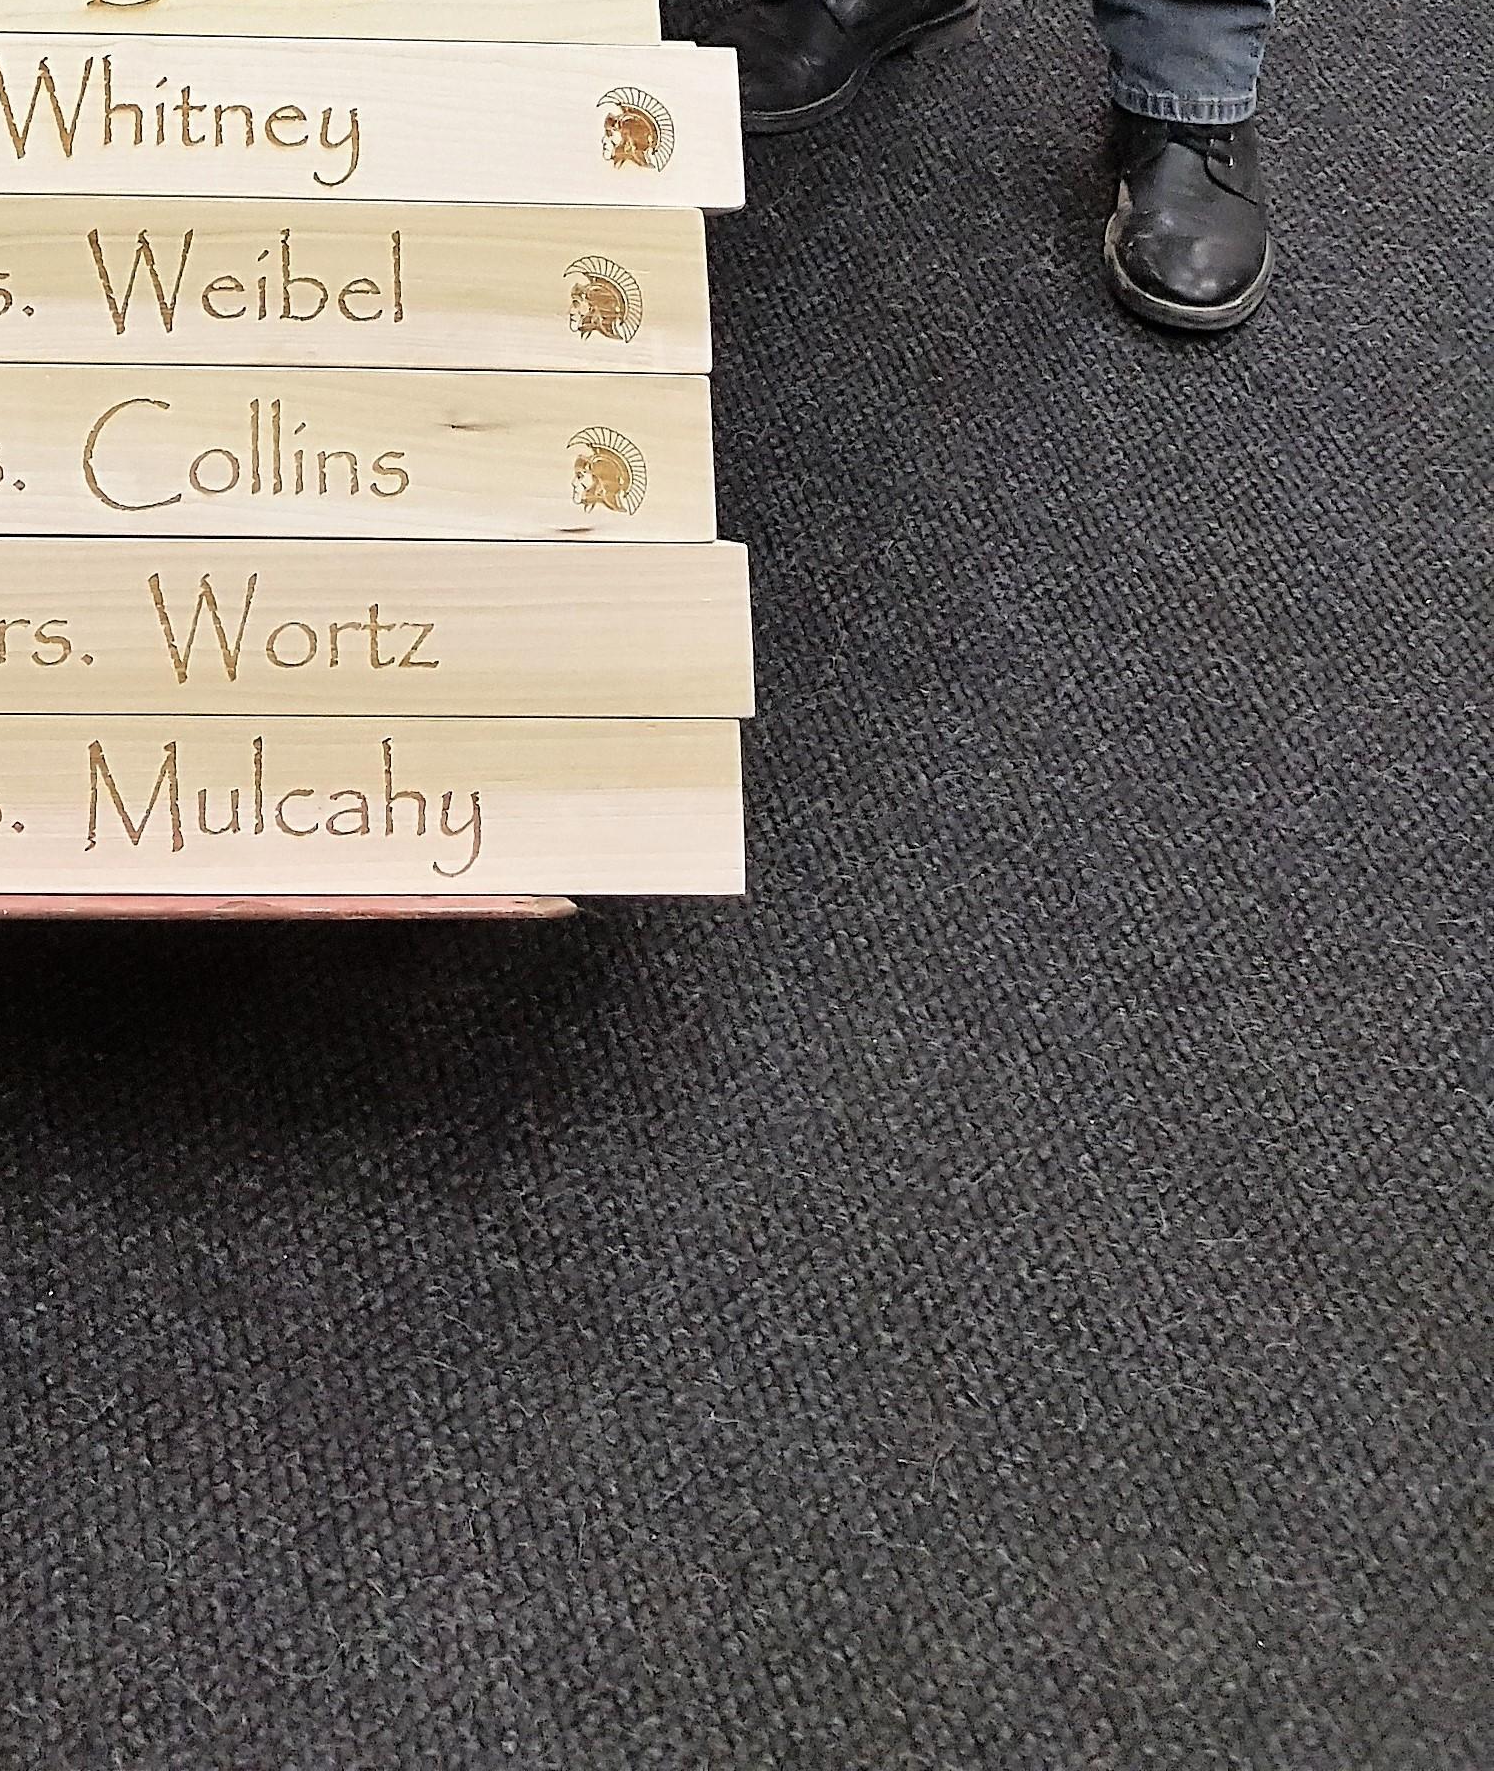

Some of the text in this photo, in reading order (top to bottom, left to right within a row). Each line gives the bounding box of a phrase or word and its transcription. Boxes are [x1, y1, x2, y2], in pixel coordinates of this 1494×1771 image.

[87, 228, 403, 335] Weibel
[83, 399, 409, 511] Collins
[148, 573, 439, 684] Wortz
[85, 736, 481, 877] Mulcahy
